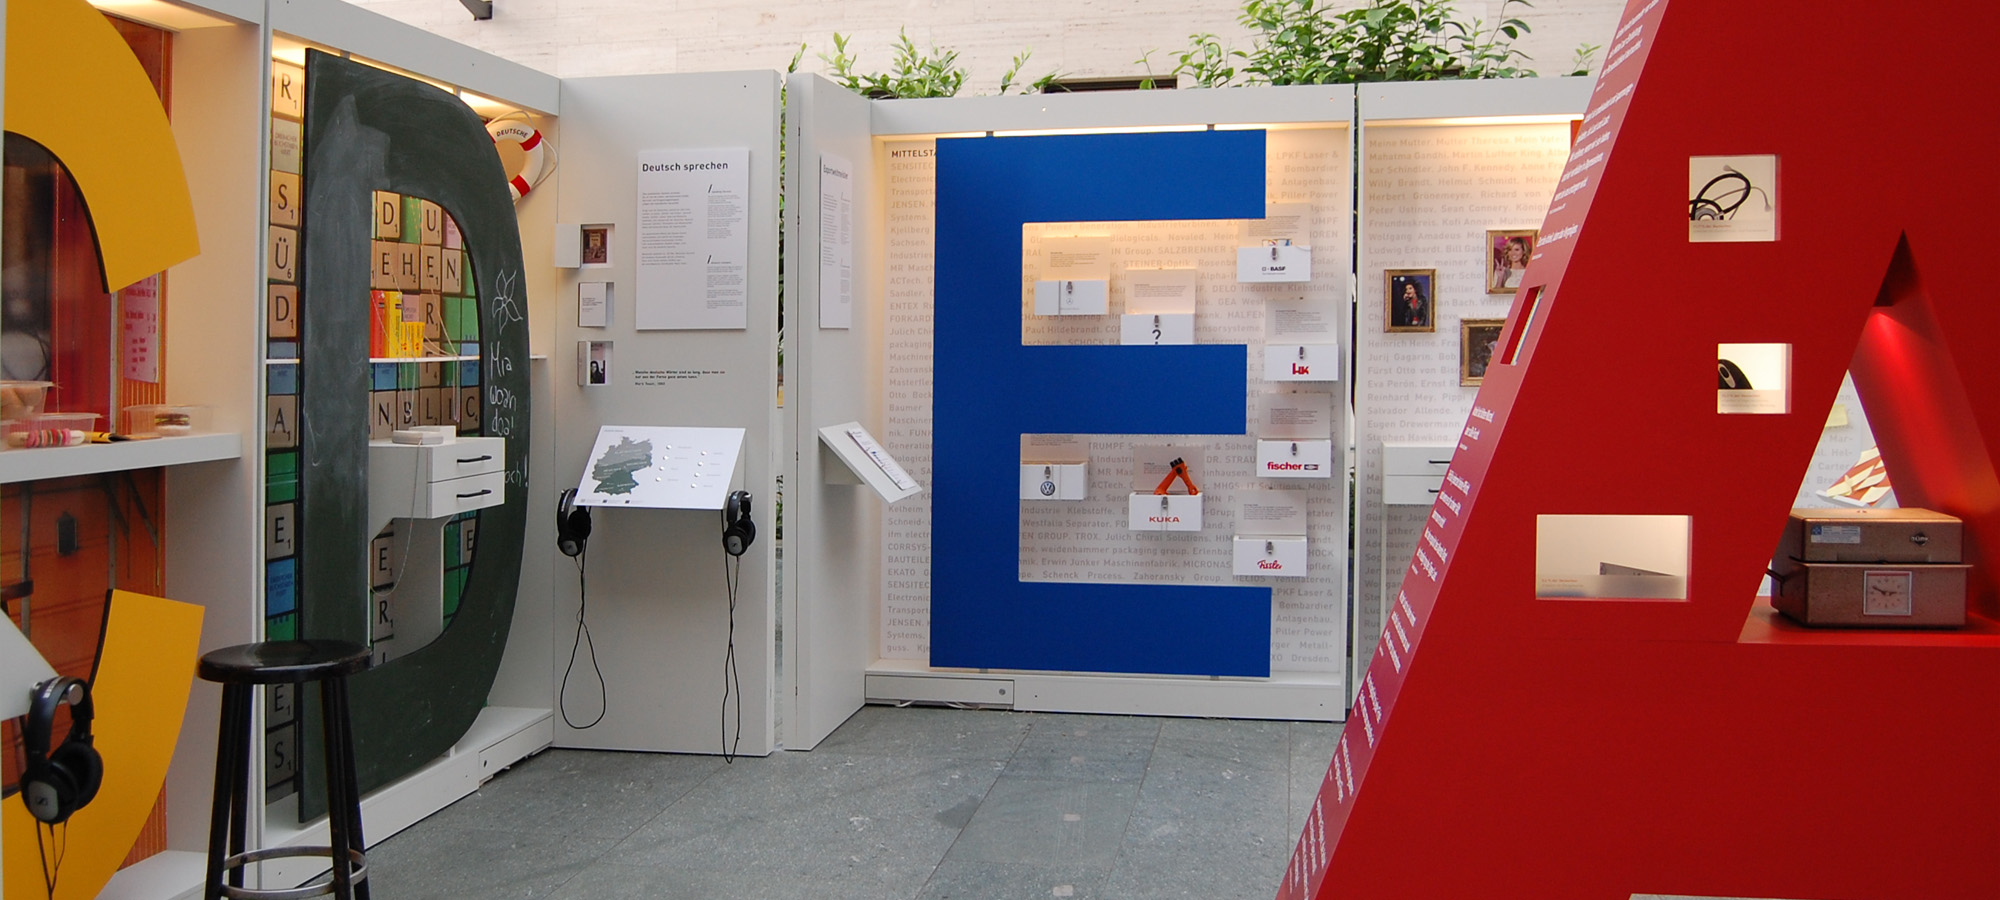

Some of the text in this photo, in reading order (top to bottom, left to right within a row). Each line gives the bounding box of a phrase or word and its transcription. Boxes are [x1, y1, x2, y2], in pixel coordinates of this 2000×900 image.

[496, 128, 528, 139] DEUTSCHE
[1369, 138, 1434, 148] Meine Mutter.
[1303, 151, 1329, 159] Laser
[1369, 150, 1516, 162] Mahatma Gandhi. Martin Luther
[642, 161, 729, 173] Deutsch sprechen
[1284, 164, 1338, 173] Bombardier
[1387, 164, 1434, 174] Schindler.
[1437, 164, 1460, 172] John
[1474, 164, 1518, 173] Kennedy.
[1281, 178, 1338, 187] Anlagenbau.
[1368, 177, 1520, 189] Willy Brandt. Helmut Schmidt.
[1281, 191, 1338, 199] Piller Power
[1368, 193, 1406, 202] Herbert
[1480, 190, 1518, 199] Richard
[1368, 204, 1512, 214] Peter Ustinov. Sean Connery.
[1442, 218, 1462, 226] Kofi
[890, 226, 930, 235] Kjellberg
[1368, 232, 1462, 243] Wolfgang Amadeus
[1368, 245, 1402, 256] Ludwig
[1368, 258, 1406, 268] Jemand
[1434, 258, 1468, 267] meiner
[1212, 285, 1237, 293] DELO
[1026, 327, 1044, 335] Paul
[1368, 339, 1408, 348] Heinrich
[1368, 353, 1389, 363] Jurij
[1394, 353, 1434, 362] Gagarin.
[1368, 366, 1393, 374] Fürst
[1396, 366, 1416, 374] Otto
[1368, 380, 1446, 388] Eva Ernst
[1368, 393, 1438, 402] Reinhard Mey.
[888, 404, 922, 412] Baumer
[1367, 407, 1408, 415] Salvador
[1367, 420, 1396, 430] Eugen
[1266, 461, 1302, 470] fischer
[888, 505, 924, 513] Kelheim
[1022, 520, 1113, 529] Westfalia Separator.
[1038, 533, 1072, 541] GROUP.
[1166, 534, 1210, 542] Solutions.
[1041, 546, 1190, 556] weidenhammer packaging group.
[1103, 560, 1181, 568] Maschinenfabrik.
[888, 568, 916, 576] EKATO
[1088, 572, 1124, 580] Process.
[1134, 572, 1185, 582] Zahoransky
[1194, 574, 1226, 582] Group.
[1298, 589, 1324, 597] Laser
[1278, 601, 1334, 610] Bombardier
[1275, 614, 1333, 624] Anlagenbau.
[1304, 628, 1333, 636] Power
[1299, 642, 1334, 650] Metall-
[1290, 655, 1333, 664] Dresden.
